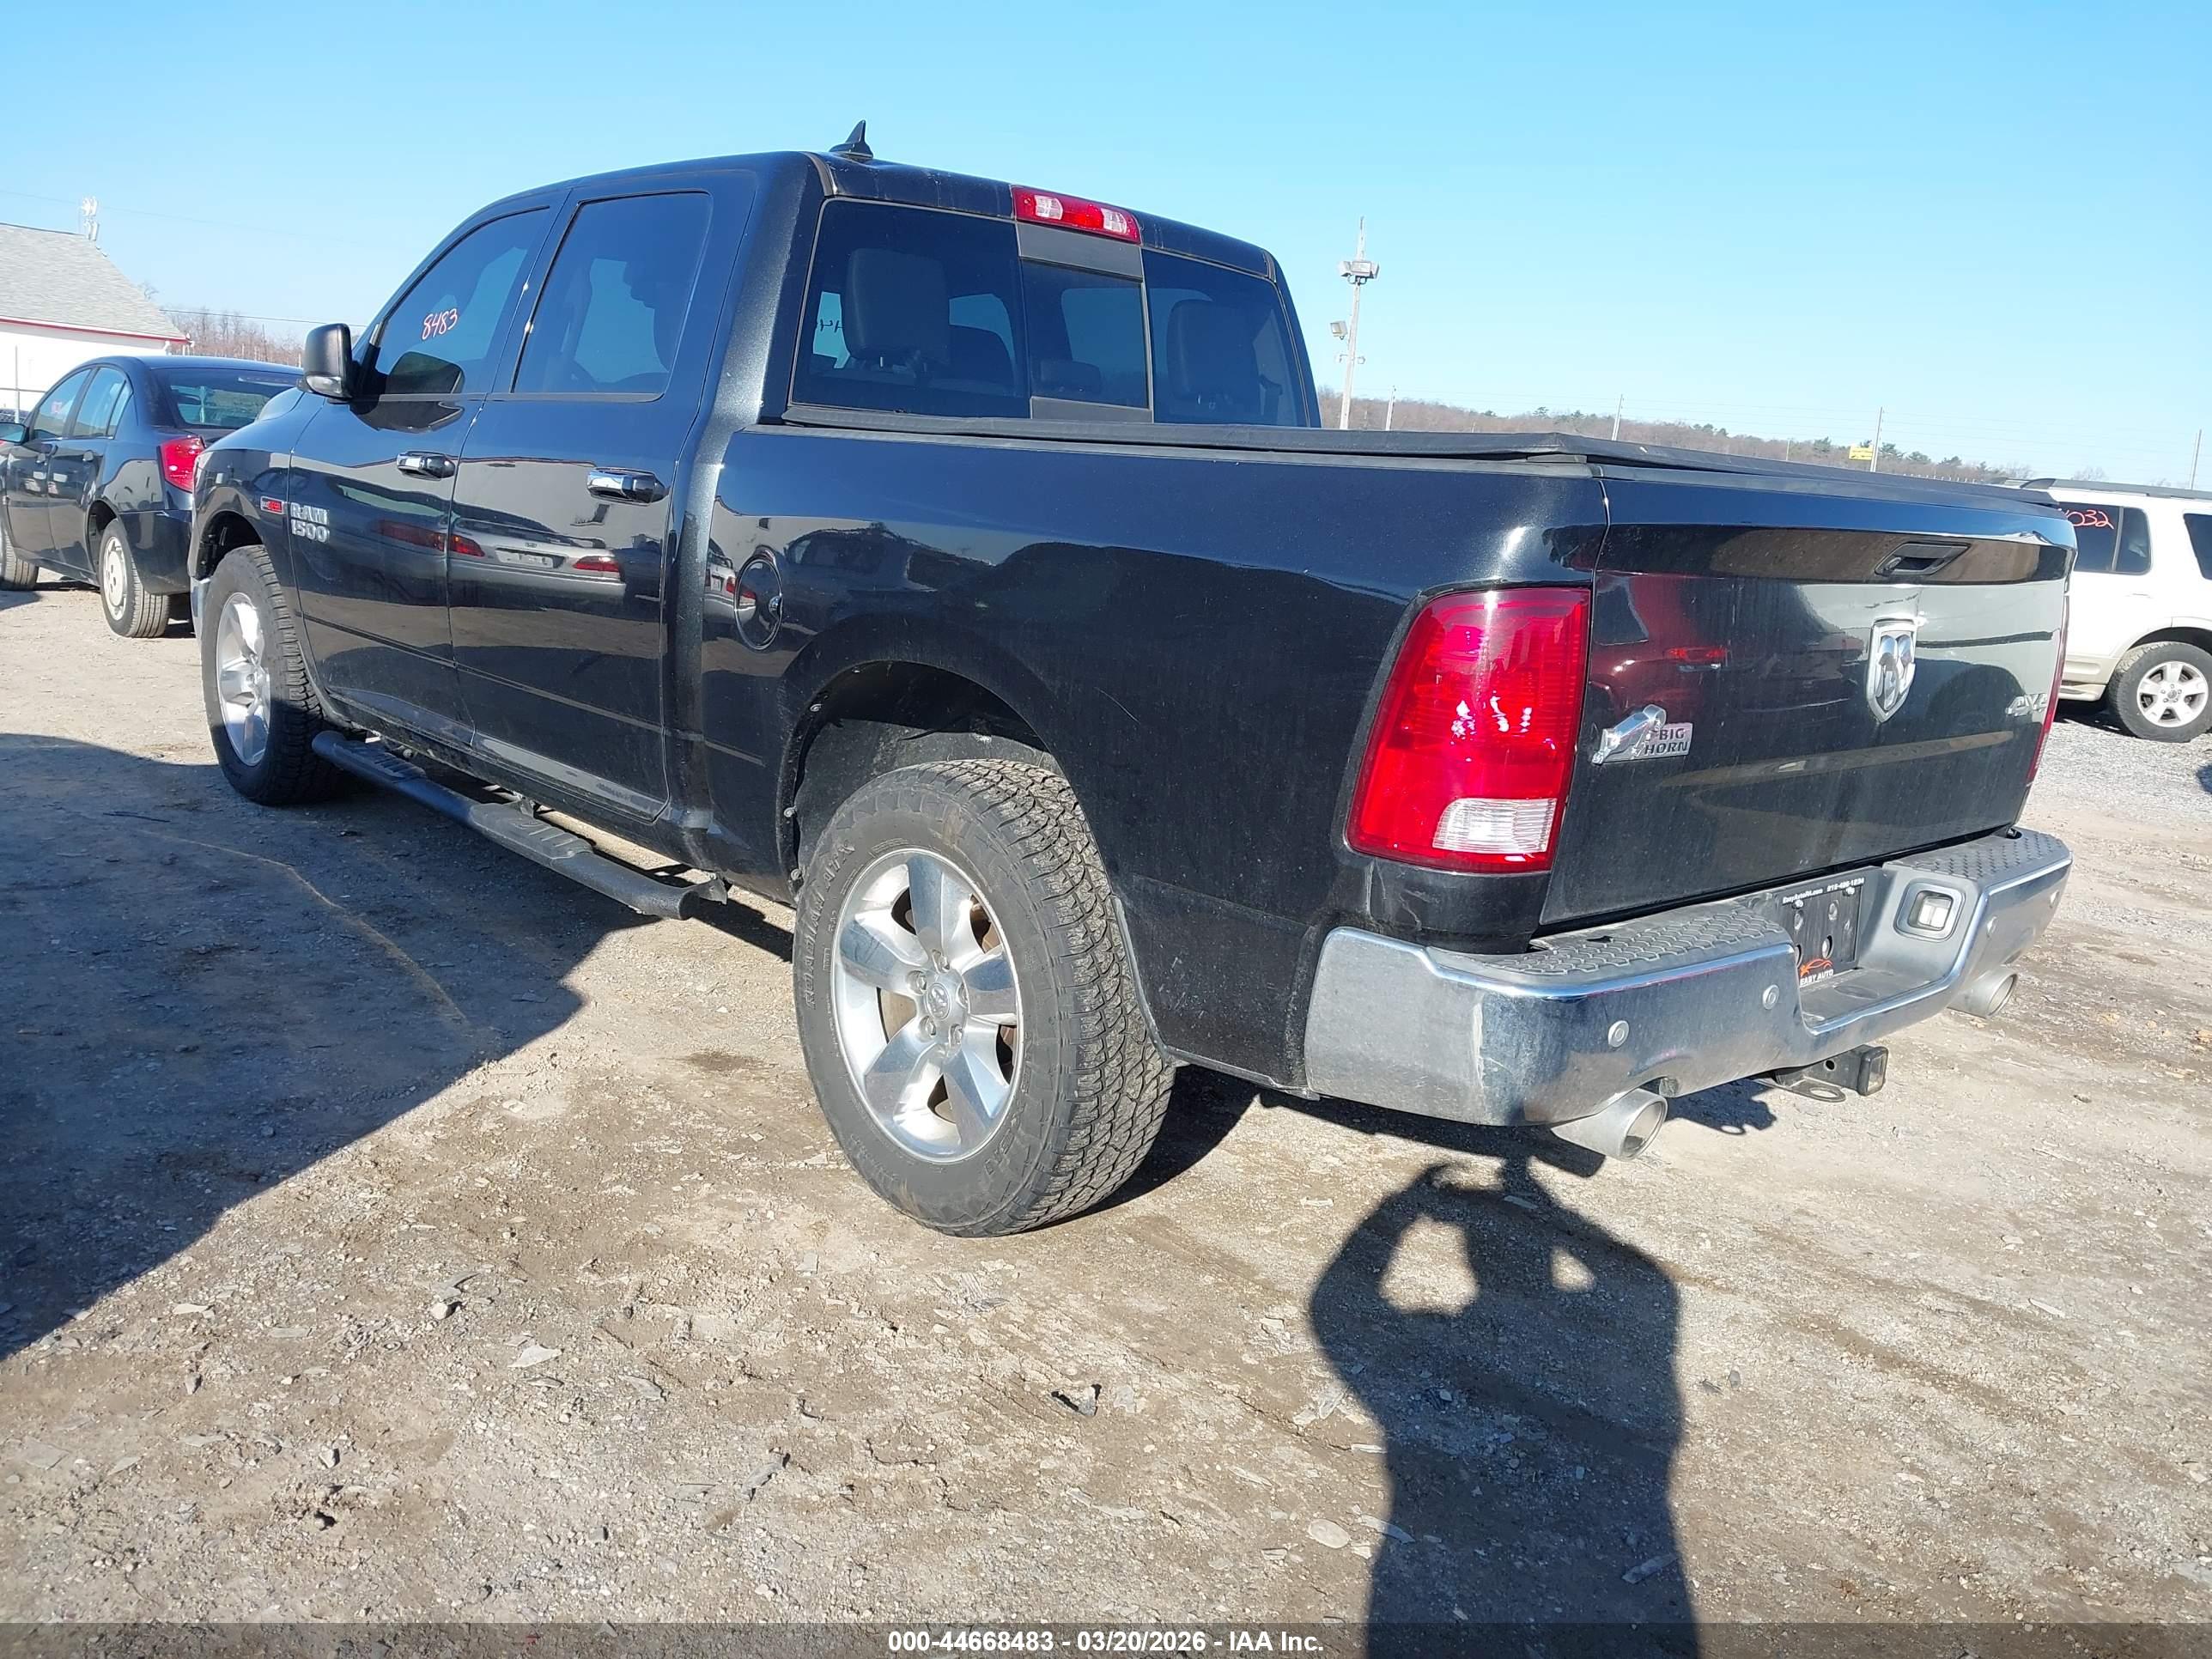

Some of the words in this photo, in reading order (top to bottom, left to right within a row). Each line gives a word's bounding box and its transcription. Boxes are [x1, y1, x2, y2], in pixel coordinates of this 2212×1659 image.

[422, 308, 458, 340] 8483
[290, 502, 329, 526] RAM
[291, 519, 330, 543] 1500
[1659, 727, 1685, 740] BIG
[1644, 741, 1688, 756] HORN
[1816, 969, 1834, 981] AUTO
